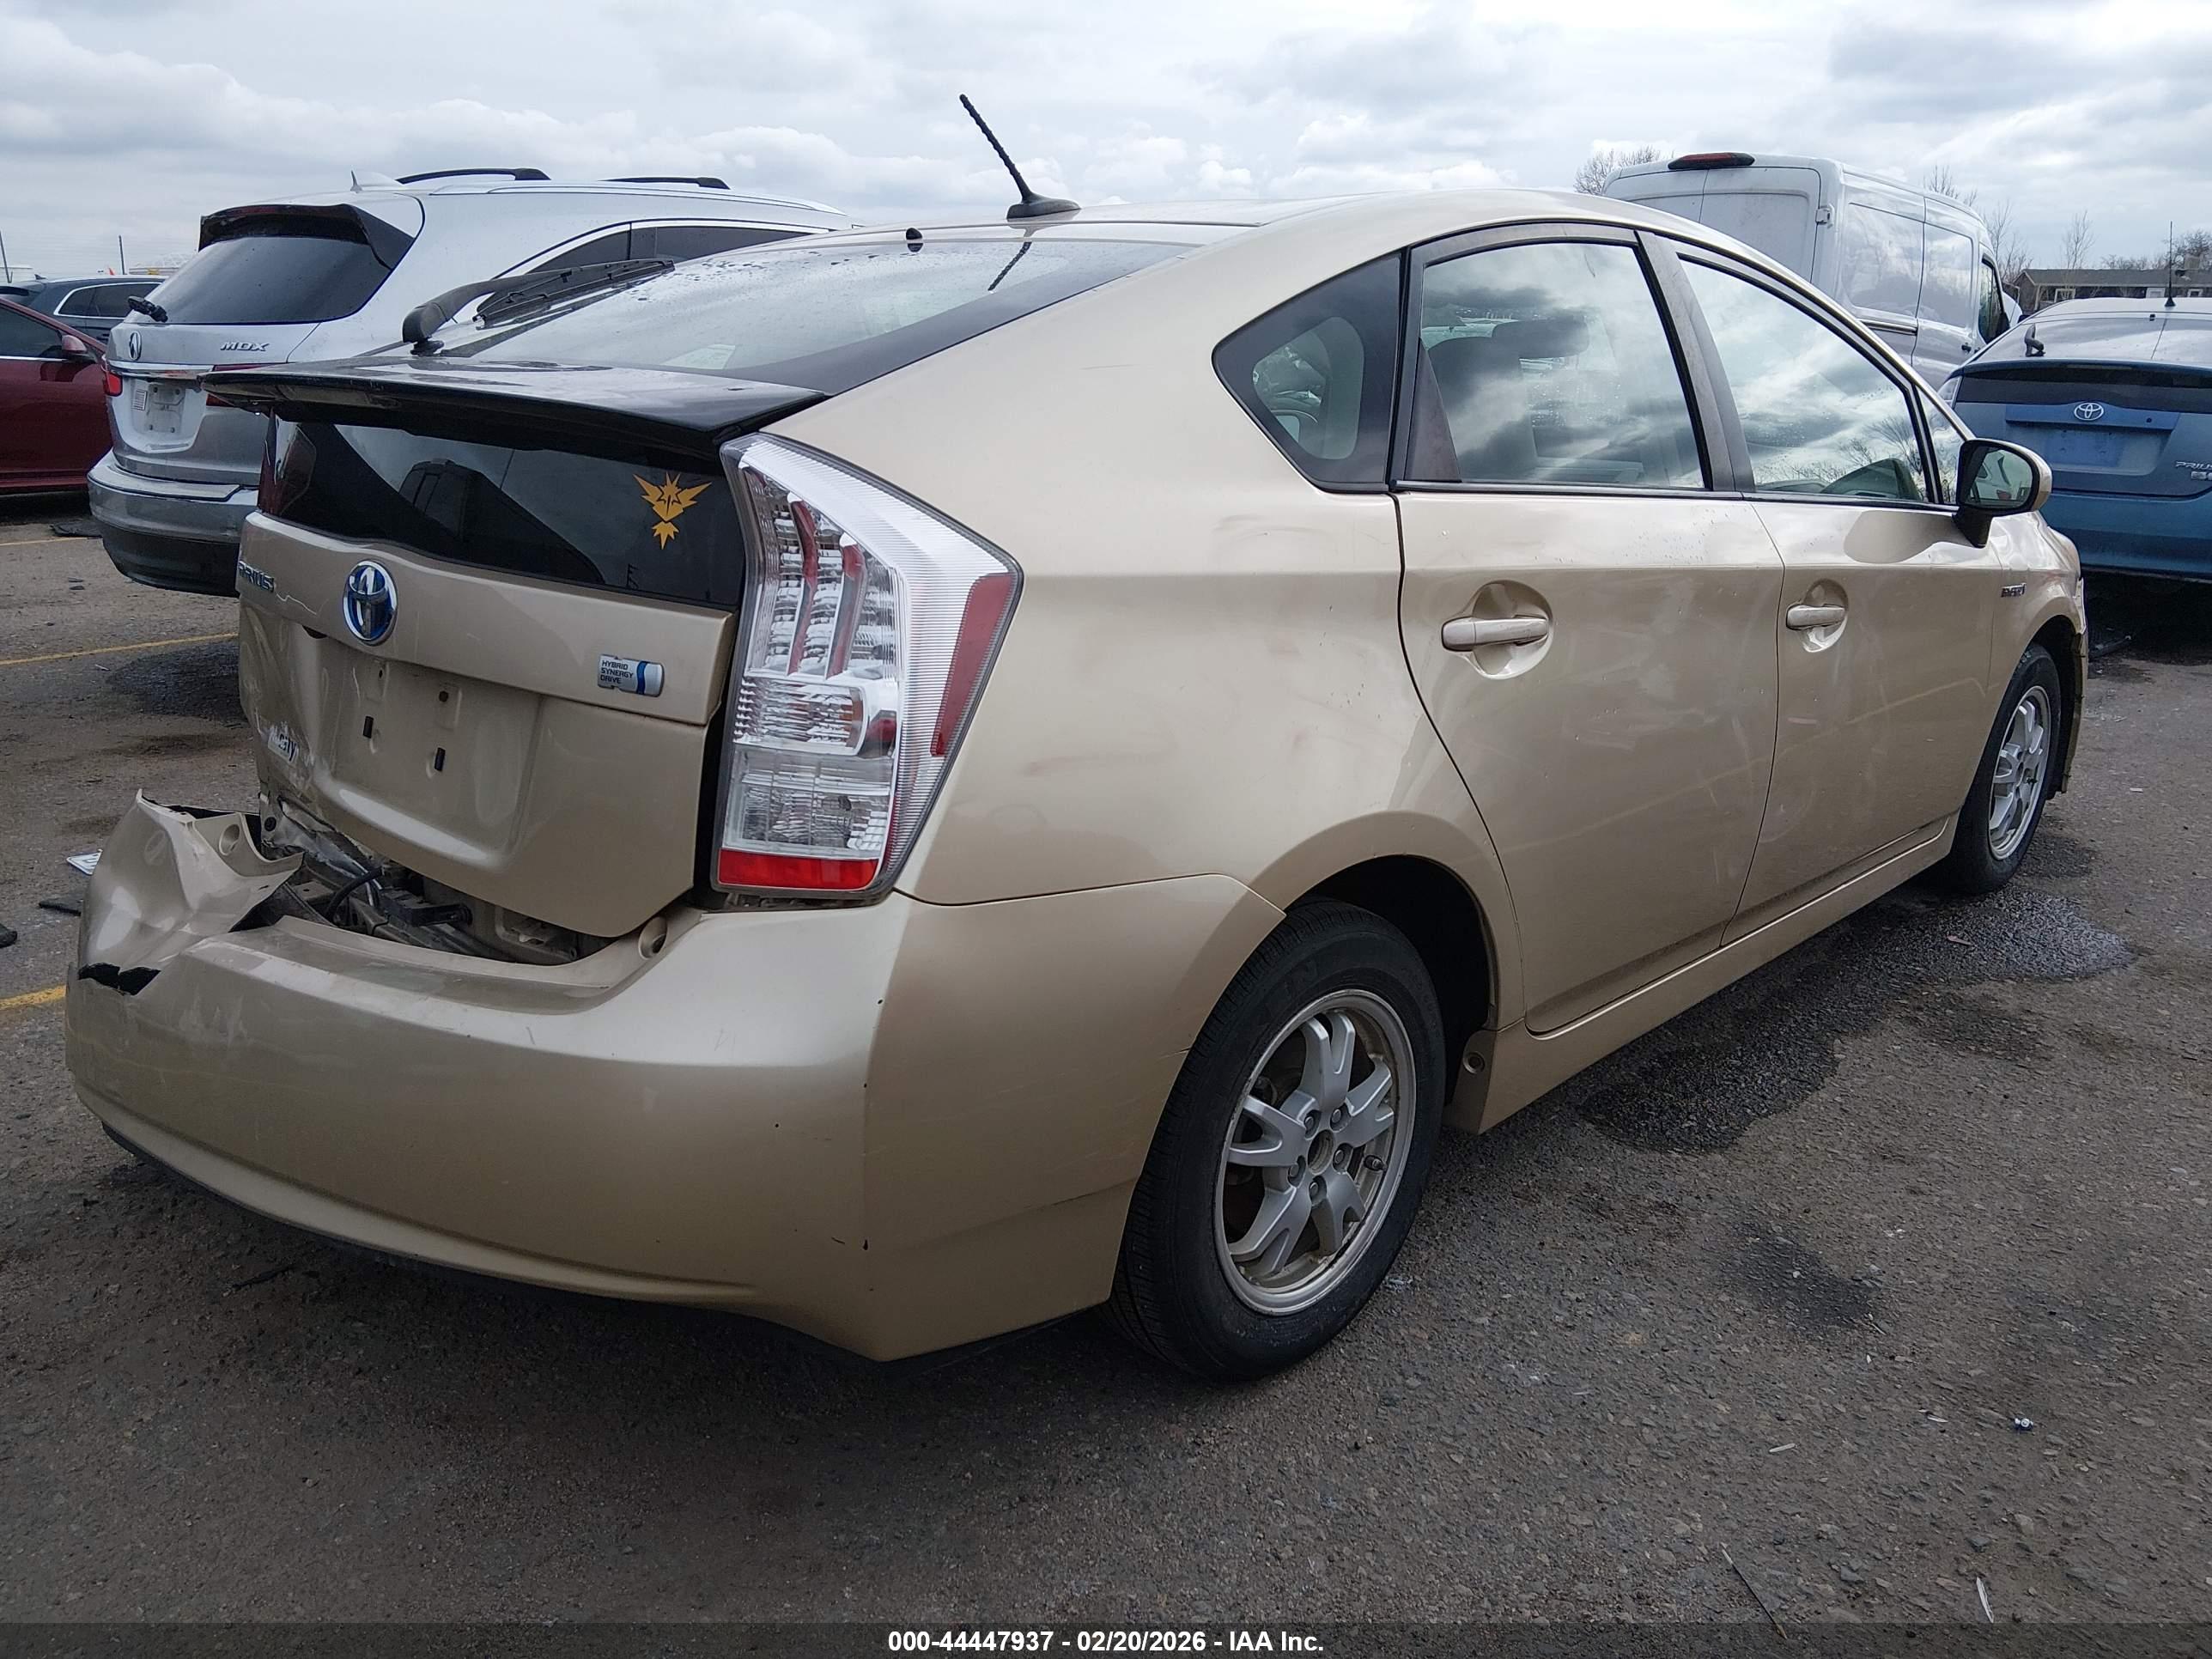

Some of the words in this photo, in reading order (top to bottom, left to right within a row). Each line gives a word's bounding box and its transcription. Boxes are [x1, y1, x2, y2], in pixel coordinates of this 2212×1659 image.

[220, 342, 270, 351] MDX
[238, 560, 275, 592] PRIUS
[602, 659, 629, 671] HYBRID
[601, 667, 634, 678] SYNERGY
[600, 674, 622, 684] DRIVE
